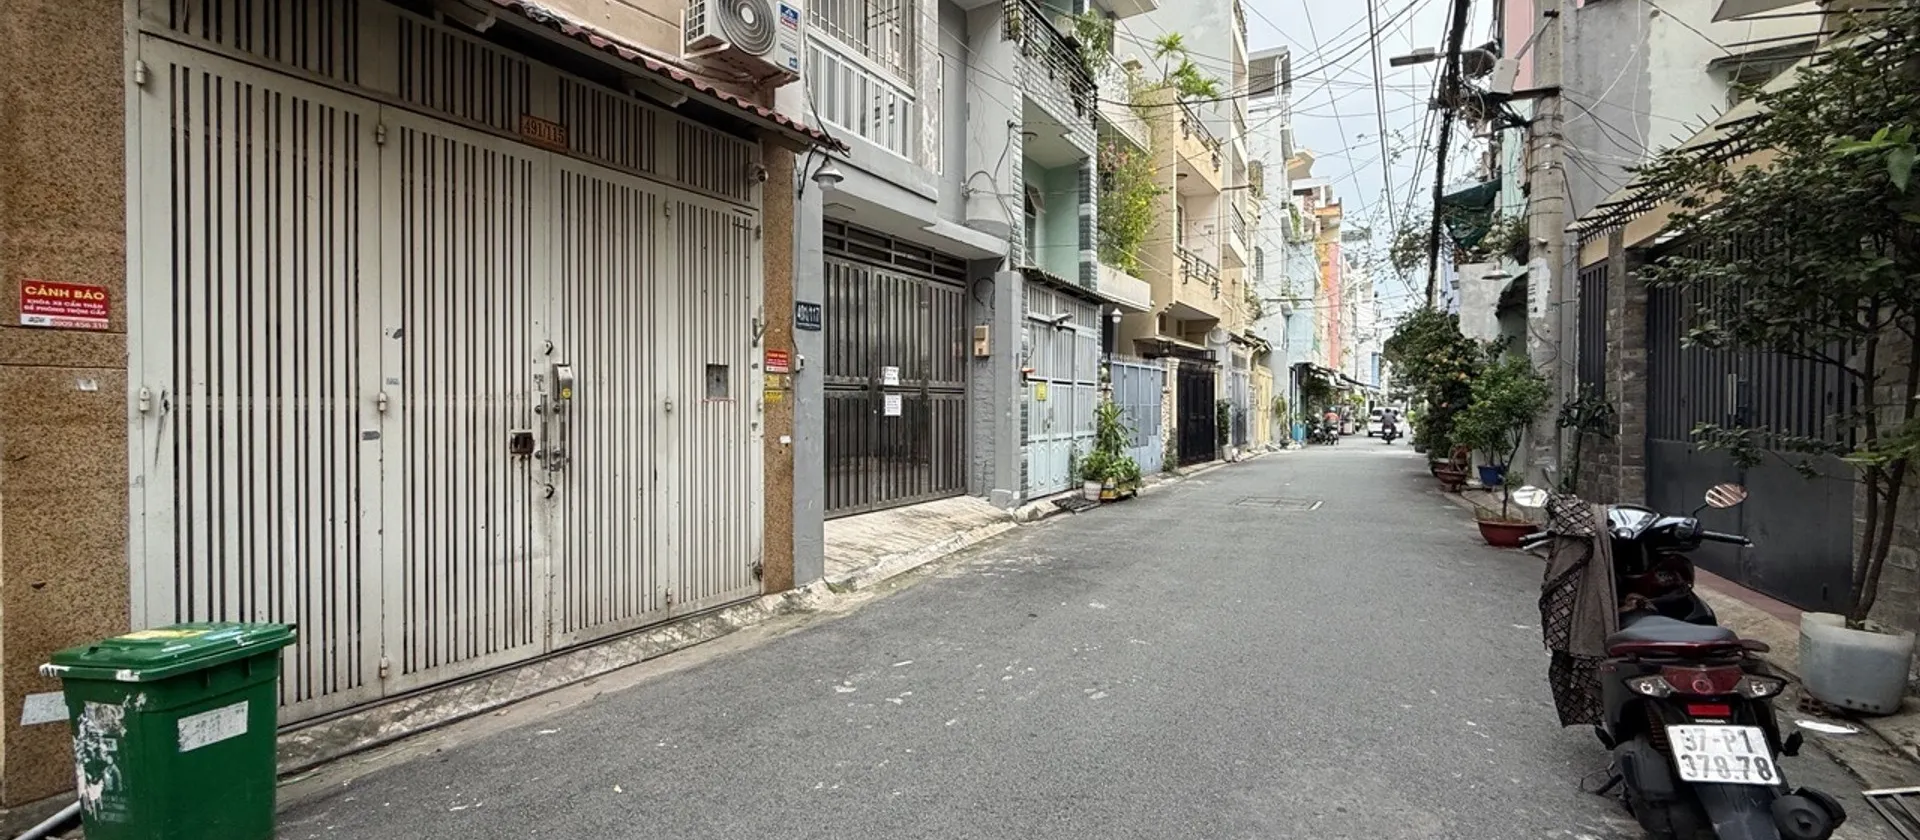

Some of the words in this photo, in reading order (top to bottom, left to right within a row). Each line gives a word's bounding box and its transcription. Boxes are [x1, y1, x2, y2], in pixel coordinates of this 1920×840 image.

[524, 118, 564, 143] 491/115
[25, 284, 70, 298] CẢNH
[74, 289, 105, 300] BÁO
